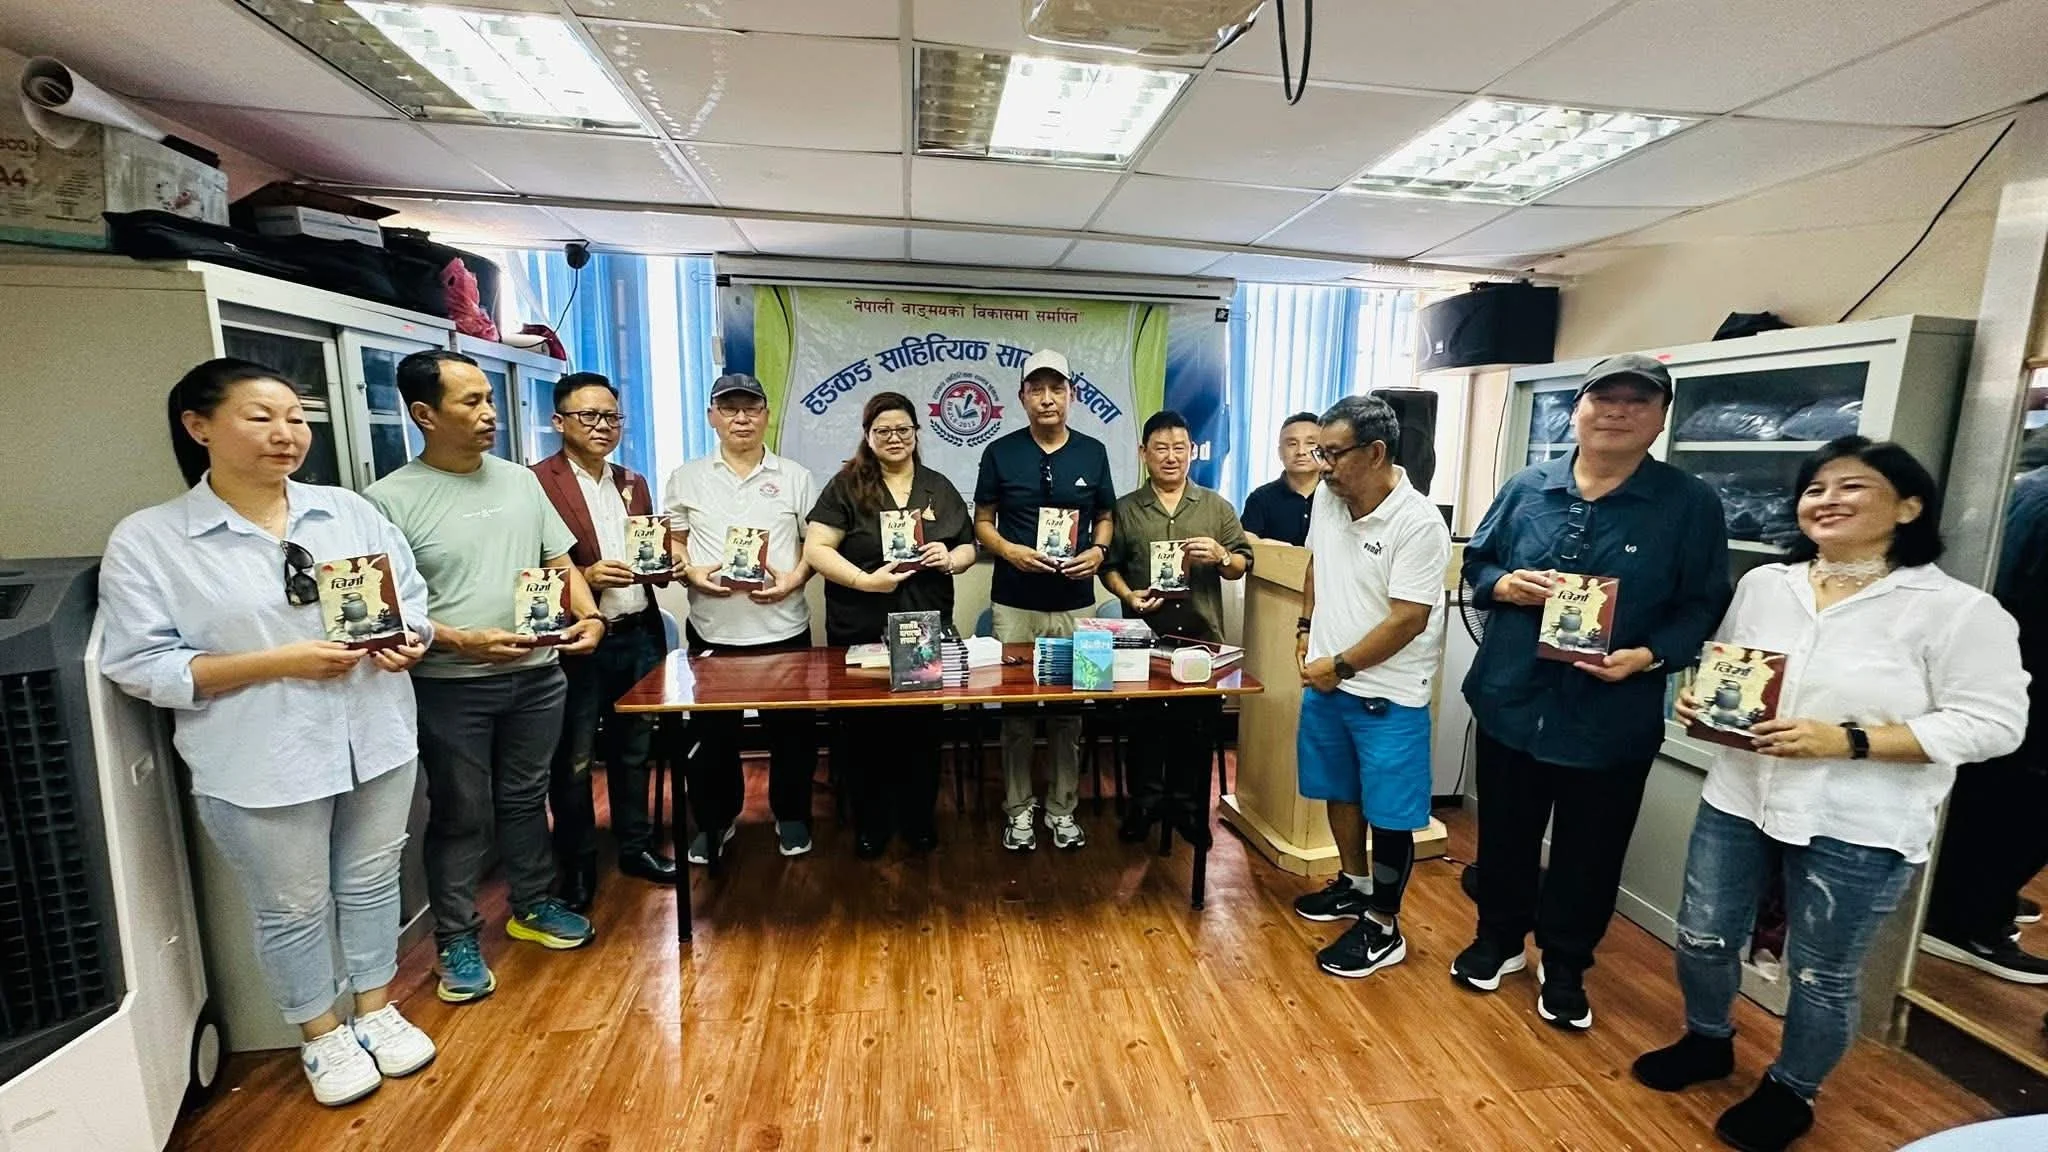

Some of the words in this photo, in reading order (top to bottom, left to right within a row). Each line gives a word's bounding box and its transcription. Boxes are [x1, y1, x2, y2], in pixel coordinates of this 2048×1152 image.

[973, 304, 1029, 320] विकासमा
[800, 358, 873, 415] हङकङ
[875, 333, 990, 373] साहित्यिक
